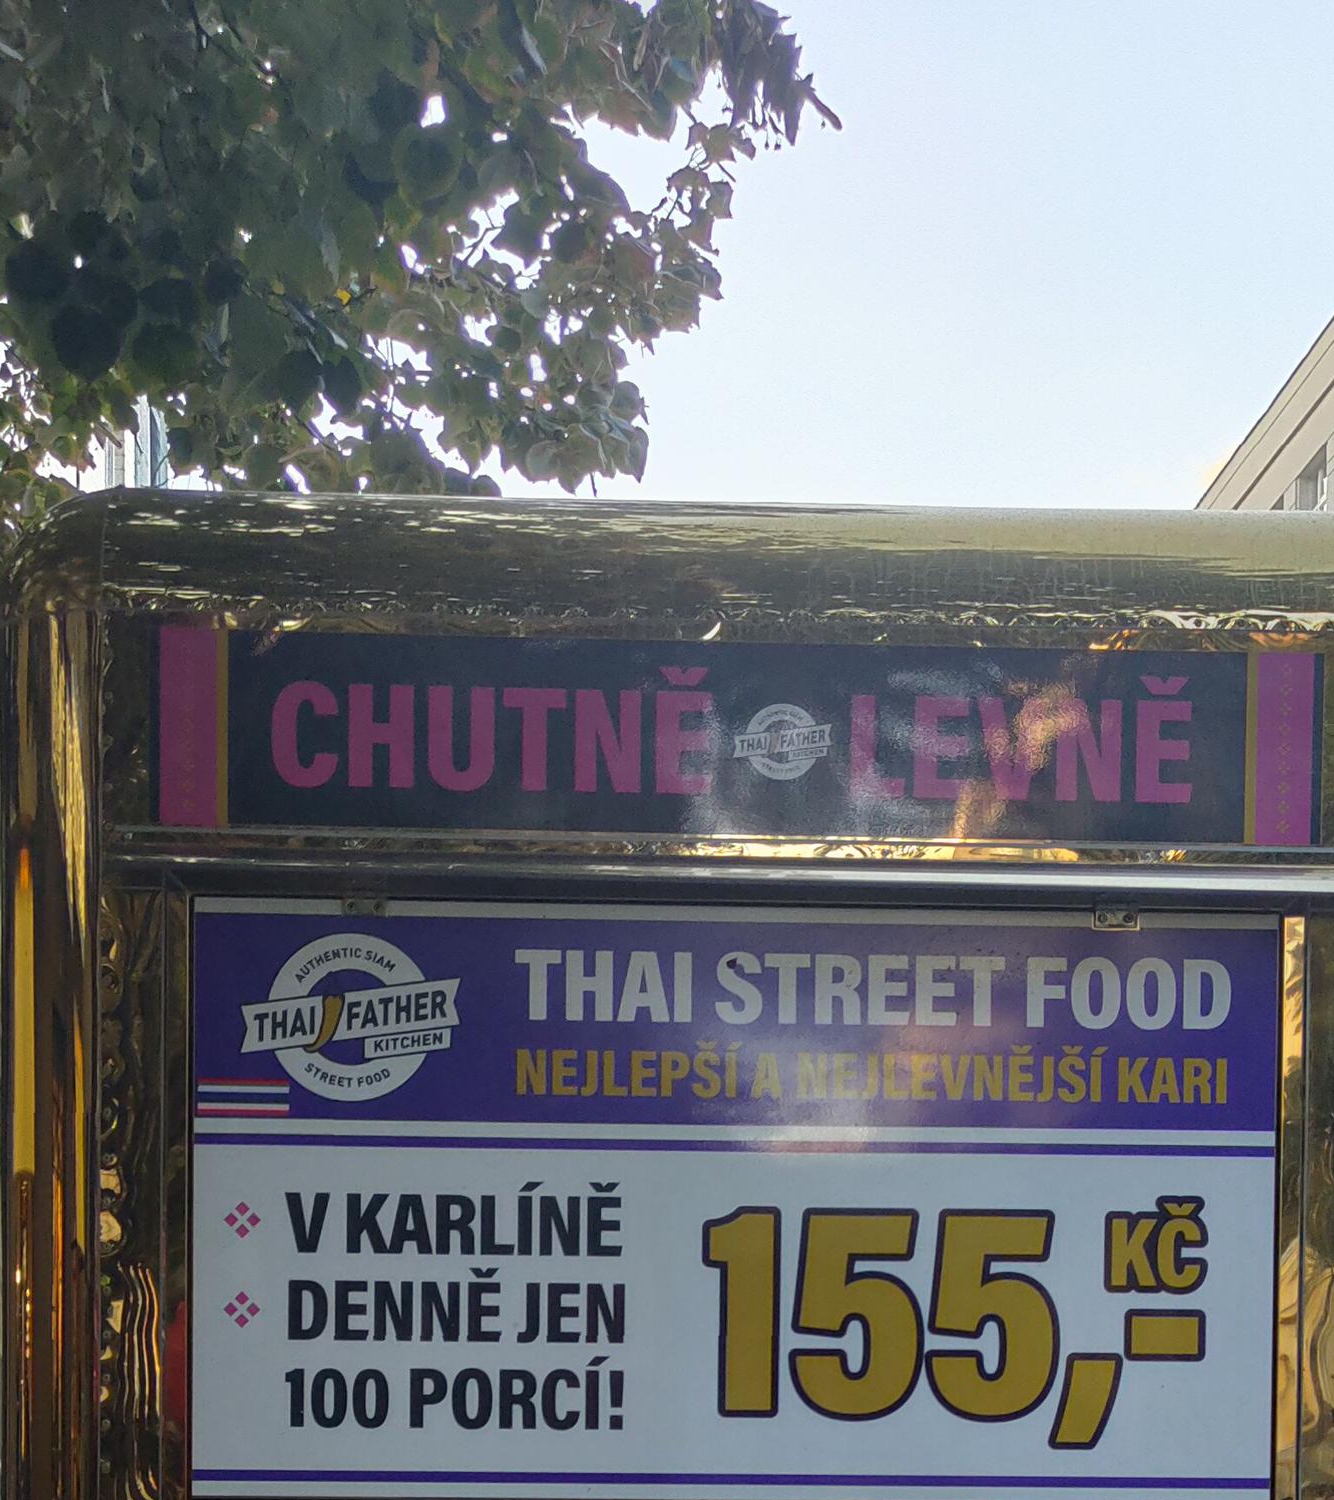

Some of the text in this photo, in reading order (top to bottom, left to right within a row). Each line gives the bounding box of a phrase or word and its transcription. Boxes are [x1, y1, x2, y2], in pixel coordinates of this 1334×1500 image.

[271, 666, 1192, 803] CHUTNĚ LEVNĚ
[739, 729, 826, 753] THAI FATHER
[294, 947, 397, 984] AUTHENTIC SIAM
[515, 949, 1232, 1031] THAI STREET FOOD
[253, 990, 448, 1042] THAI FATHER
[373, 1031, 444, 1053] KITCHEN
[304, 1063, 392, 1089] STREET FOOD
[516, 1039, 1228, 1105] NEJLEPŠÍ A NEJLEVNĚJŠÍ KARI
[284, 1181, 623, 1257] V KARLÍNĚ
[1104, 1195, 1208, 1295] KČ
[287, 1267, 626, 1343] DENNĚ JEN
[284, 1356, 625, 1430] 100 PORCÍ!
